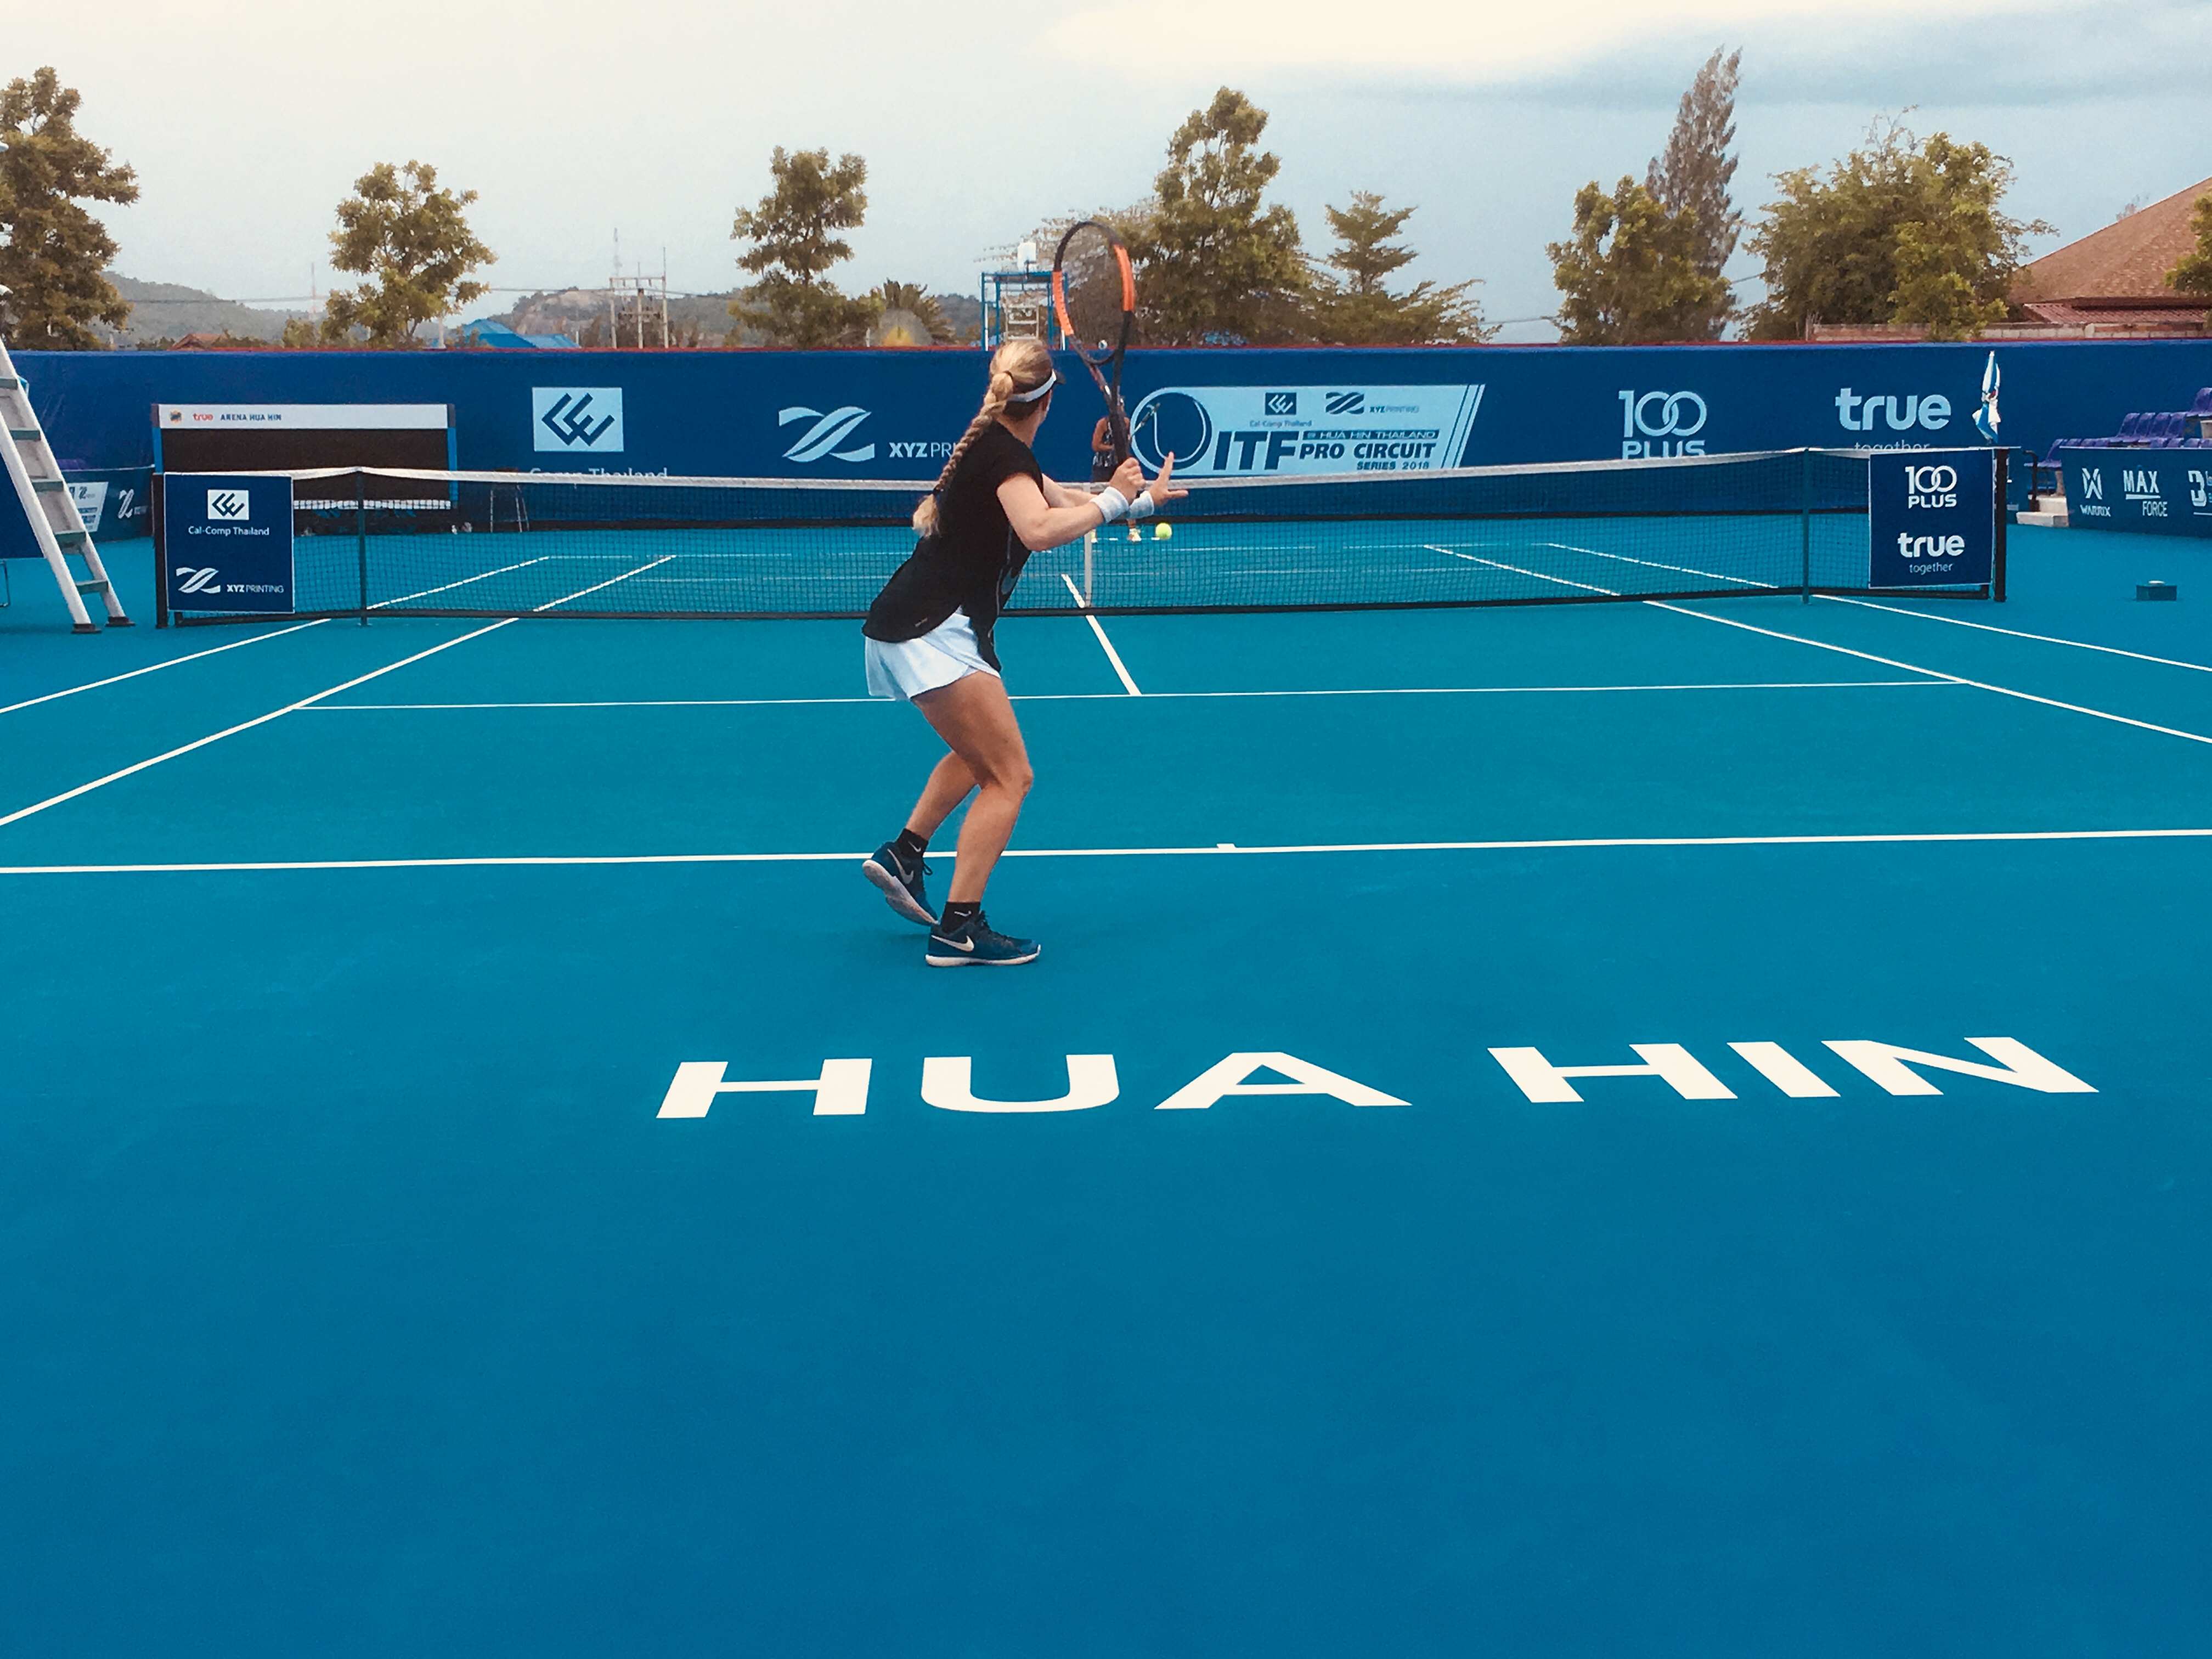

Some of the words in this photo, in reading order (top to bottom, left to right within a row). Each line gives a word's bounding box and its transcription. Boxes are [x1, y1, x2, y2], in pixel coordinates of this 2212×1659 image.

[193, 413, 213, 421] true
[1618, 391, 1707, 438] 100
[1835, 388, 1951, 431] true
[1320, 431, 1346, 439] HUA
[1350, 431, 1371, 439] HIN
[1376, 431, 1436, 439] THAILAND
[1213, 431, 1299, 470] ITF
[1299, 443, 1345, 459] PRO
[1353, 443, 1437, 459] CIRCUIT
[1622, 440, 1706, 460] PLUS
[1357, 461, 1396, 470] SERIES
[1402, 461, 1430, 470] 2018
[1905, 465, 1957, 494] 100
[2123, 470, 2160, 493] MAX
[1908, 494, 1957, 509] PLUS
[2142, 501, 2168, 517] FORCE
[188, 526, 231, 537] Cal-Comp
[233, 527, 269, 535] Thailand
[1897, 533, 1965, 558] true
[1909, 562, 1953, 575] together
[656, 1051, 1413, 1118] HUA
[1487, 1036, 2100, 1103] HIN
